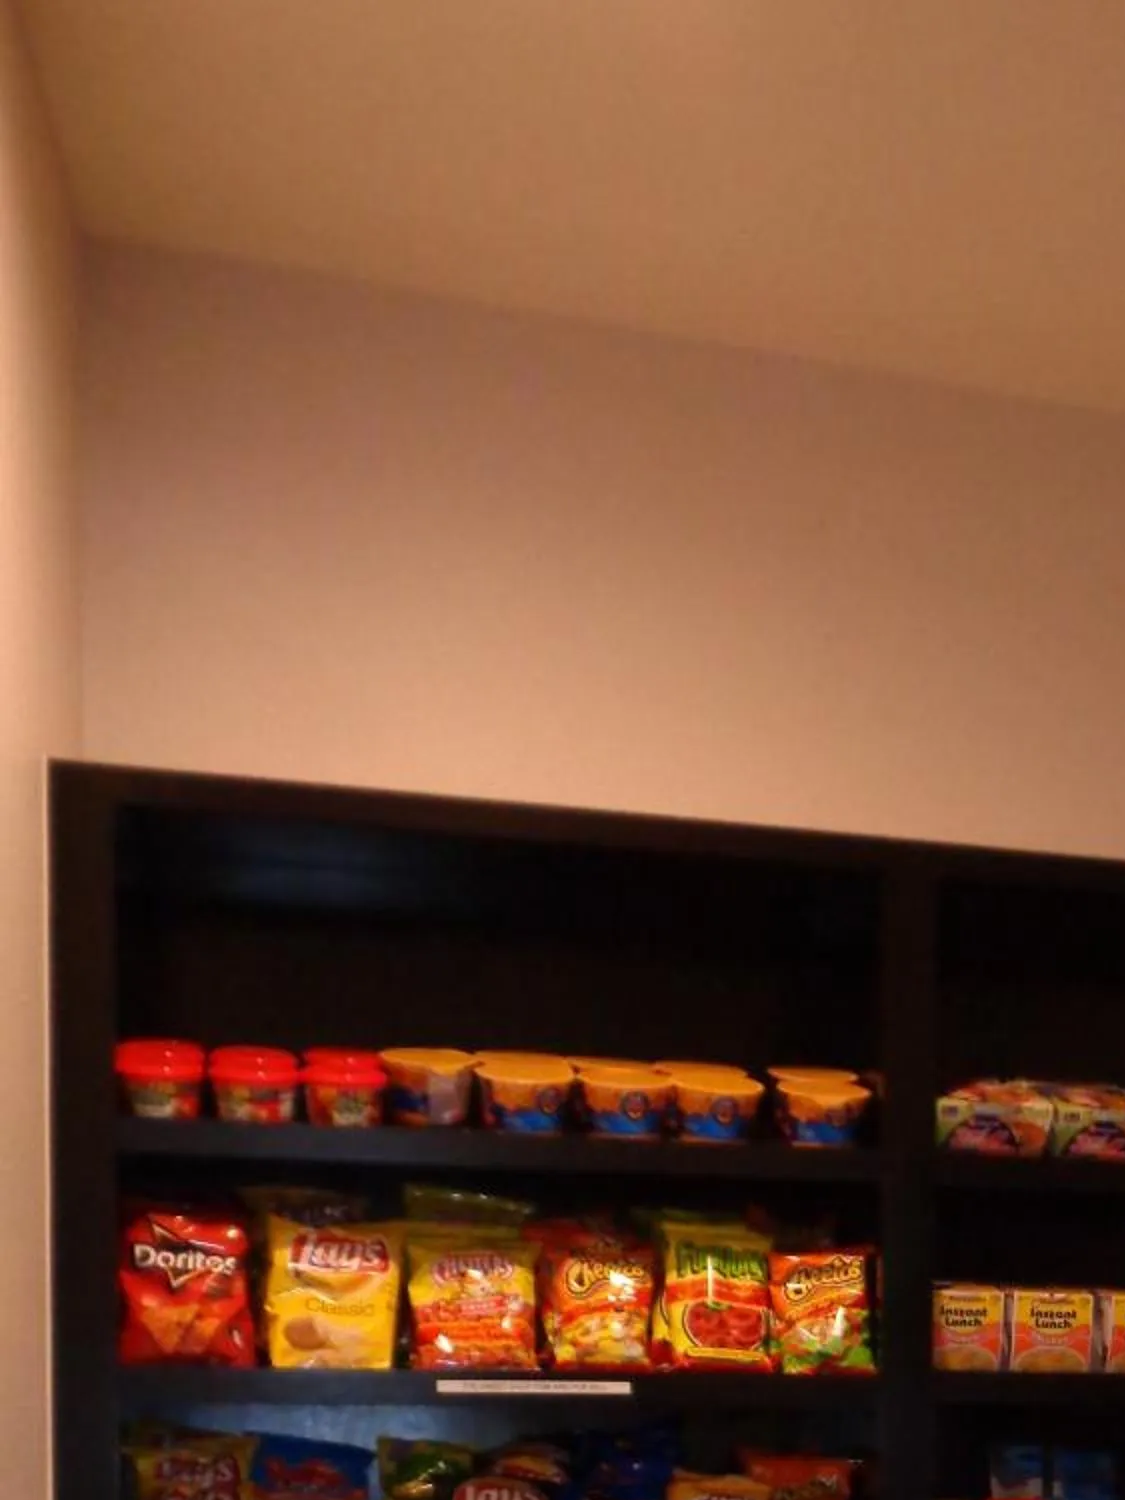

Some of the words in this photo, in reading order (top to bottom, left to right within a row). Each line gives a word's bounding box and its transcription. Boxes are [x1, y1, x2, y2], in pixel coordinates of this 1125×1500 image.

[132, 1241, 238, 1276] Doritos
[304, 1297, 375, 1318] Classic
[940, 1304, 988, 1317] Instant
[1030, 1306, 1078, 1320] Instant
[944, 1316, 983, 1328] Lunch
[1034, 1319, 1073, 1330] Lunch
